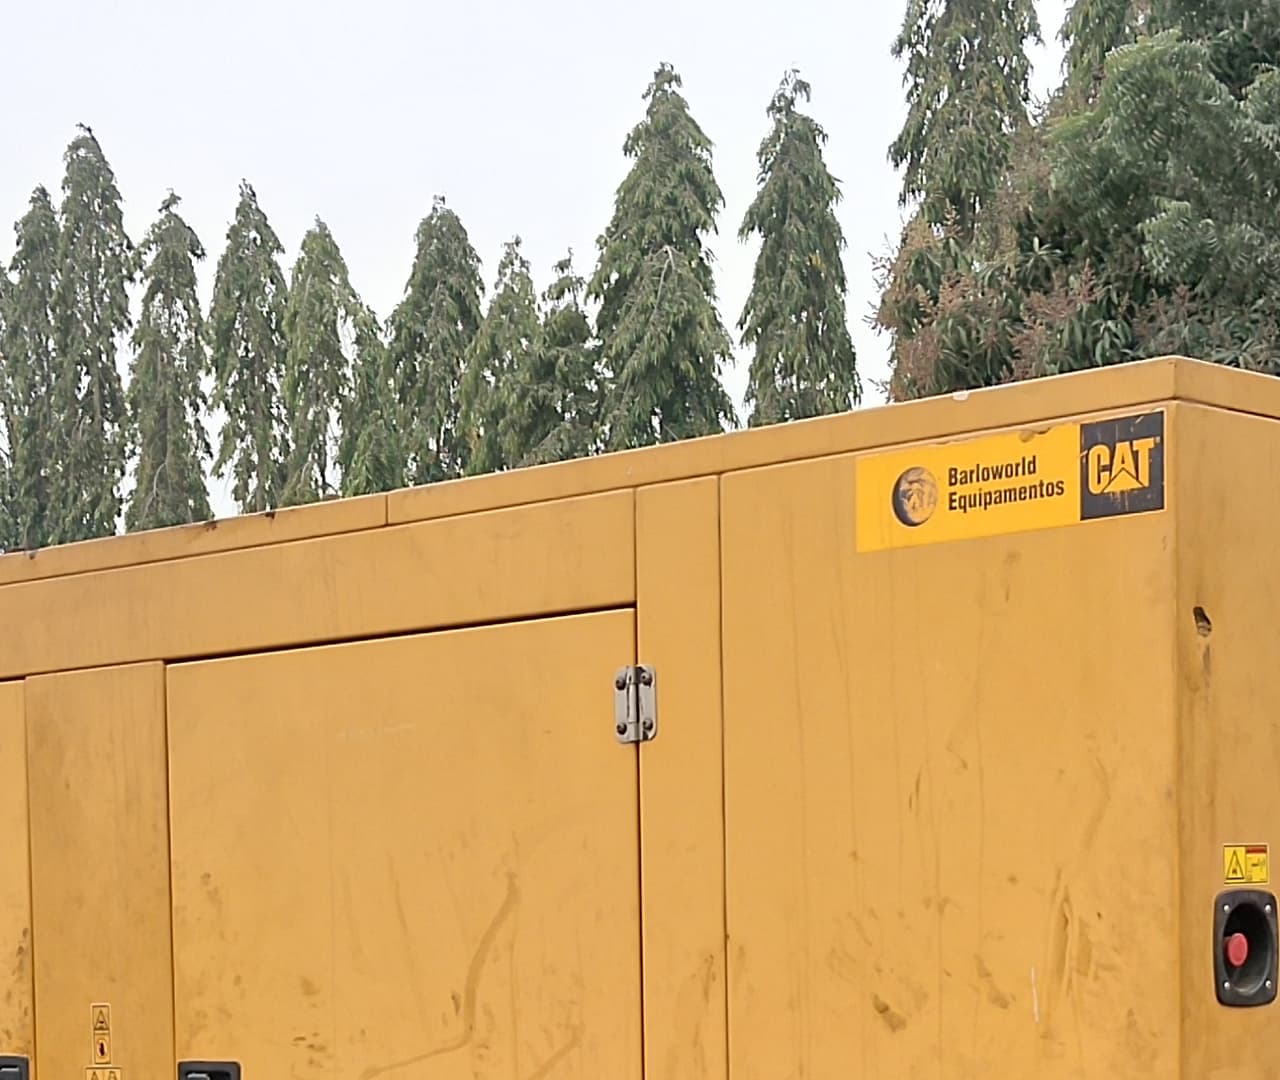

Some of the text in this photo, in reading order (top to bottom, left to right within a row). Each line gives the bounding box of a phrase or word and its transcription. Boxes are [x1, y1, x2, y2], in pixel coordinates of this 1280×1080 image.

[948, 456, 1037, 487] Barloworld
[1088, 437, 1154, 495] CAT
[948, 479, 1065, 513] Equipamentos
